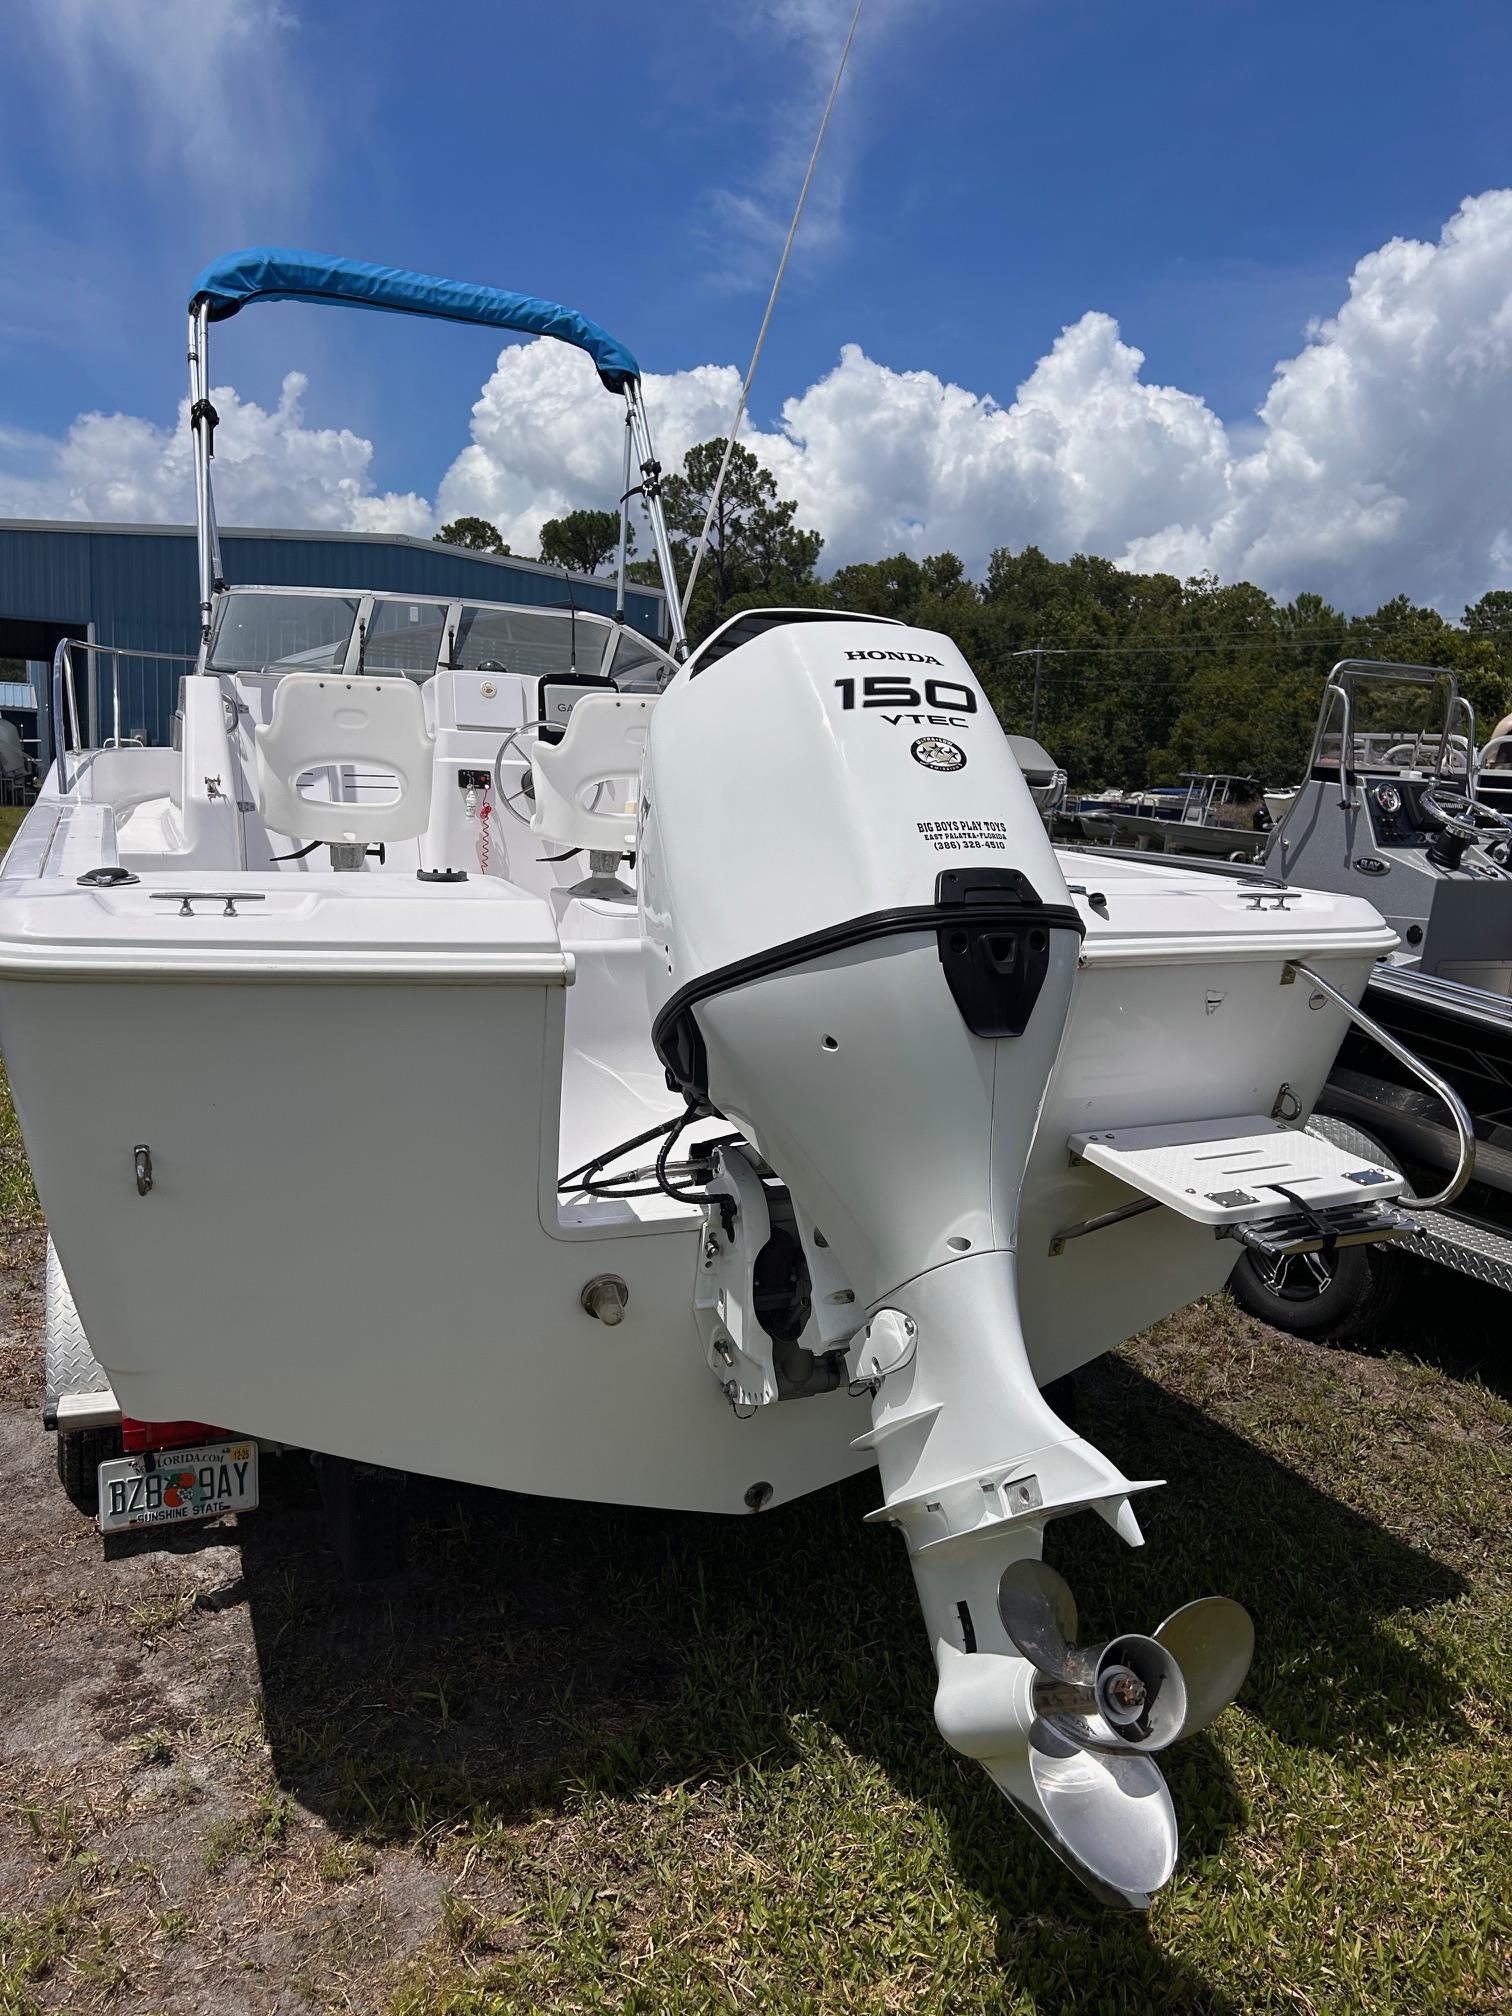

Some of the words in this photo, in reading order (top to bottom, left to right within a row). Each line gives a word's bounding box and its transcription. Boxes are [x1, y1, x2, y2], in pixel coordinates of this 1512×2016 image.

[844, 650, 945, 667] HONDA
[834, 676, 978, 714] 150
[880, 714, 969, 728] VTEC
[916, 822, 934, 833] BIG
[934, 821, 959, 832] BOYS
[960, 821, 982, 831] PLAY
[983, 821, 1007, 832] TOYS
[924, 833, 943, 841] EAST
[934, 841, 961, 851] (386)
[962, 840, 1006, 850] 328-4510
[1361, 859, 1380, 872] BAY
[108, 1475, 163, 1516] BZ8
[199, 1462, 248, 1500] 9AY
[136, 1508, 188, 1523] SUNSHINE
[192, 1502, 225, 1516] STATE
